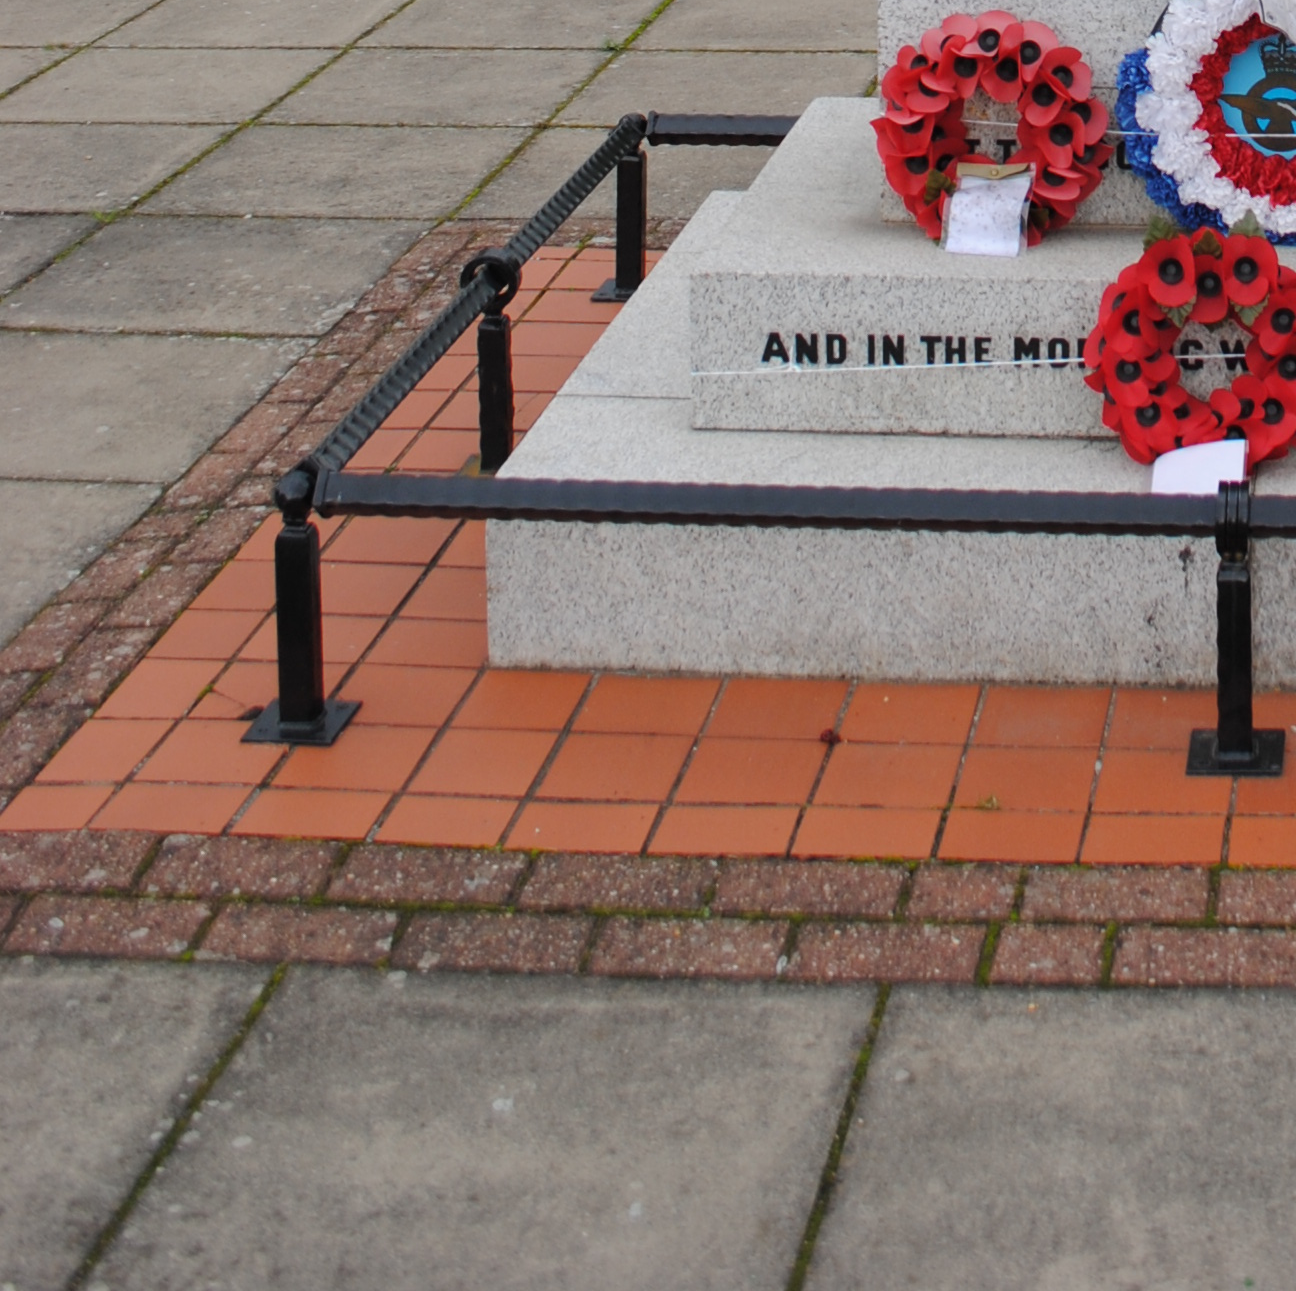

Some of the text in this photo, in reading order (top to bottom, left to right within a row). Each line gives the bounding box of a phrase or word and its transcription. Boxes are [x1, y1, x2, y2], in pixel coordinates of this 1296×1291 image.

[762, 332, 847, 365] AND
[868, 335, 904, 365] IN
[920, 336, 991, 364] THE
